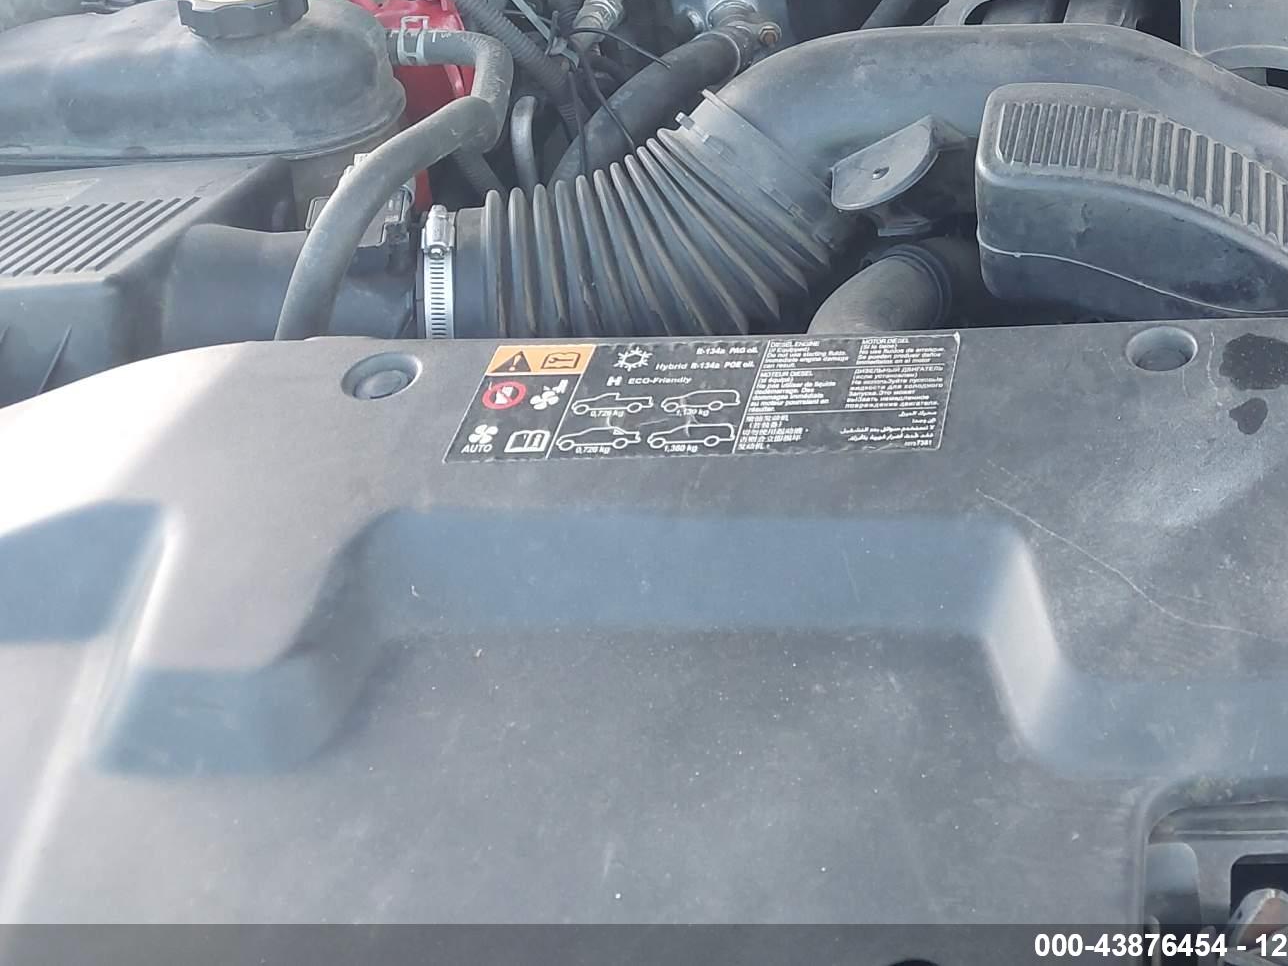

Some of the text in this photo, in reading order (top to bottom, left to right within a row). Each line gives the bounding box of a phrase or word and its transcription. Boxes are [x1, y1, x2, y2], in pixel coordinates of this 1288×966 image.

[655, 362, 688, 371] Hybrid
[691, 362, 721, 370] R-134a
[723, 361, 741, 369] POE
[628, 376, 692, 386] ECO-Friendly
[461, 443, 493, 454] AUTO
